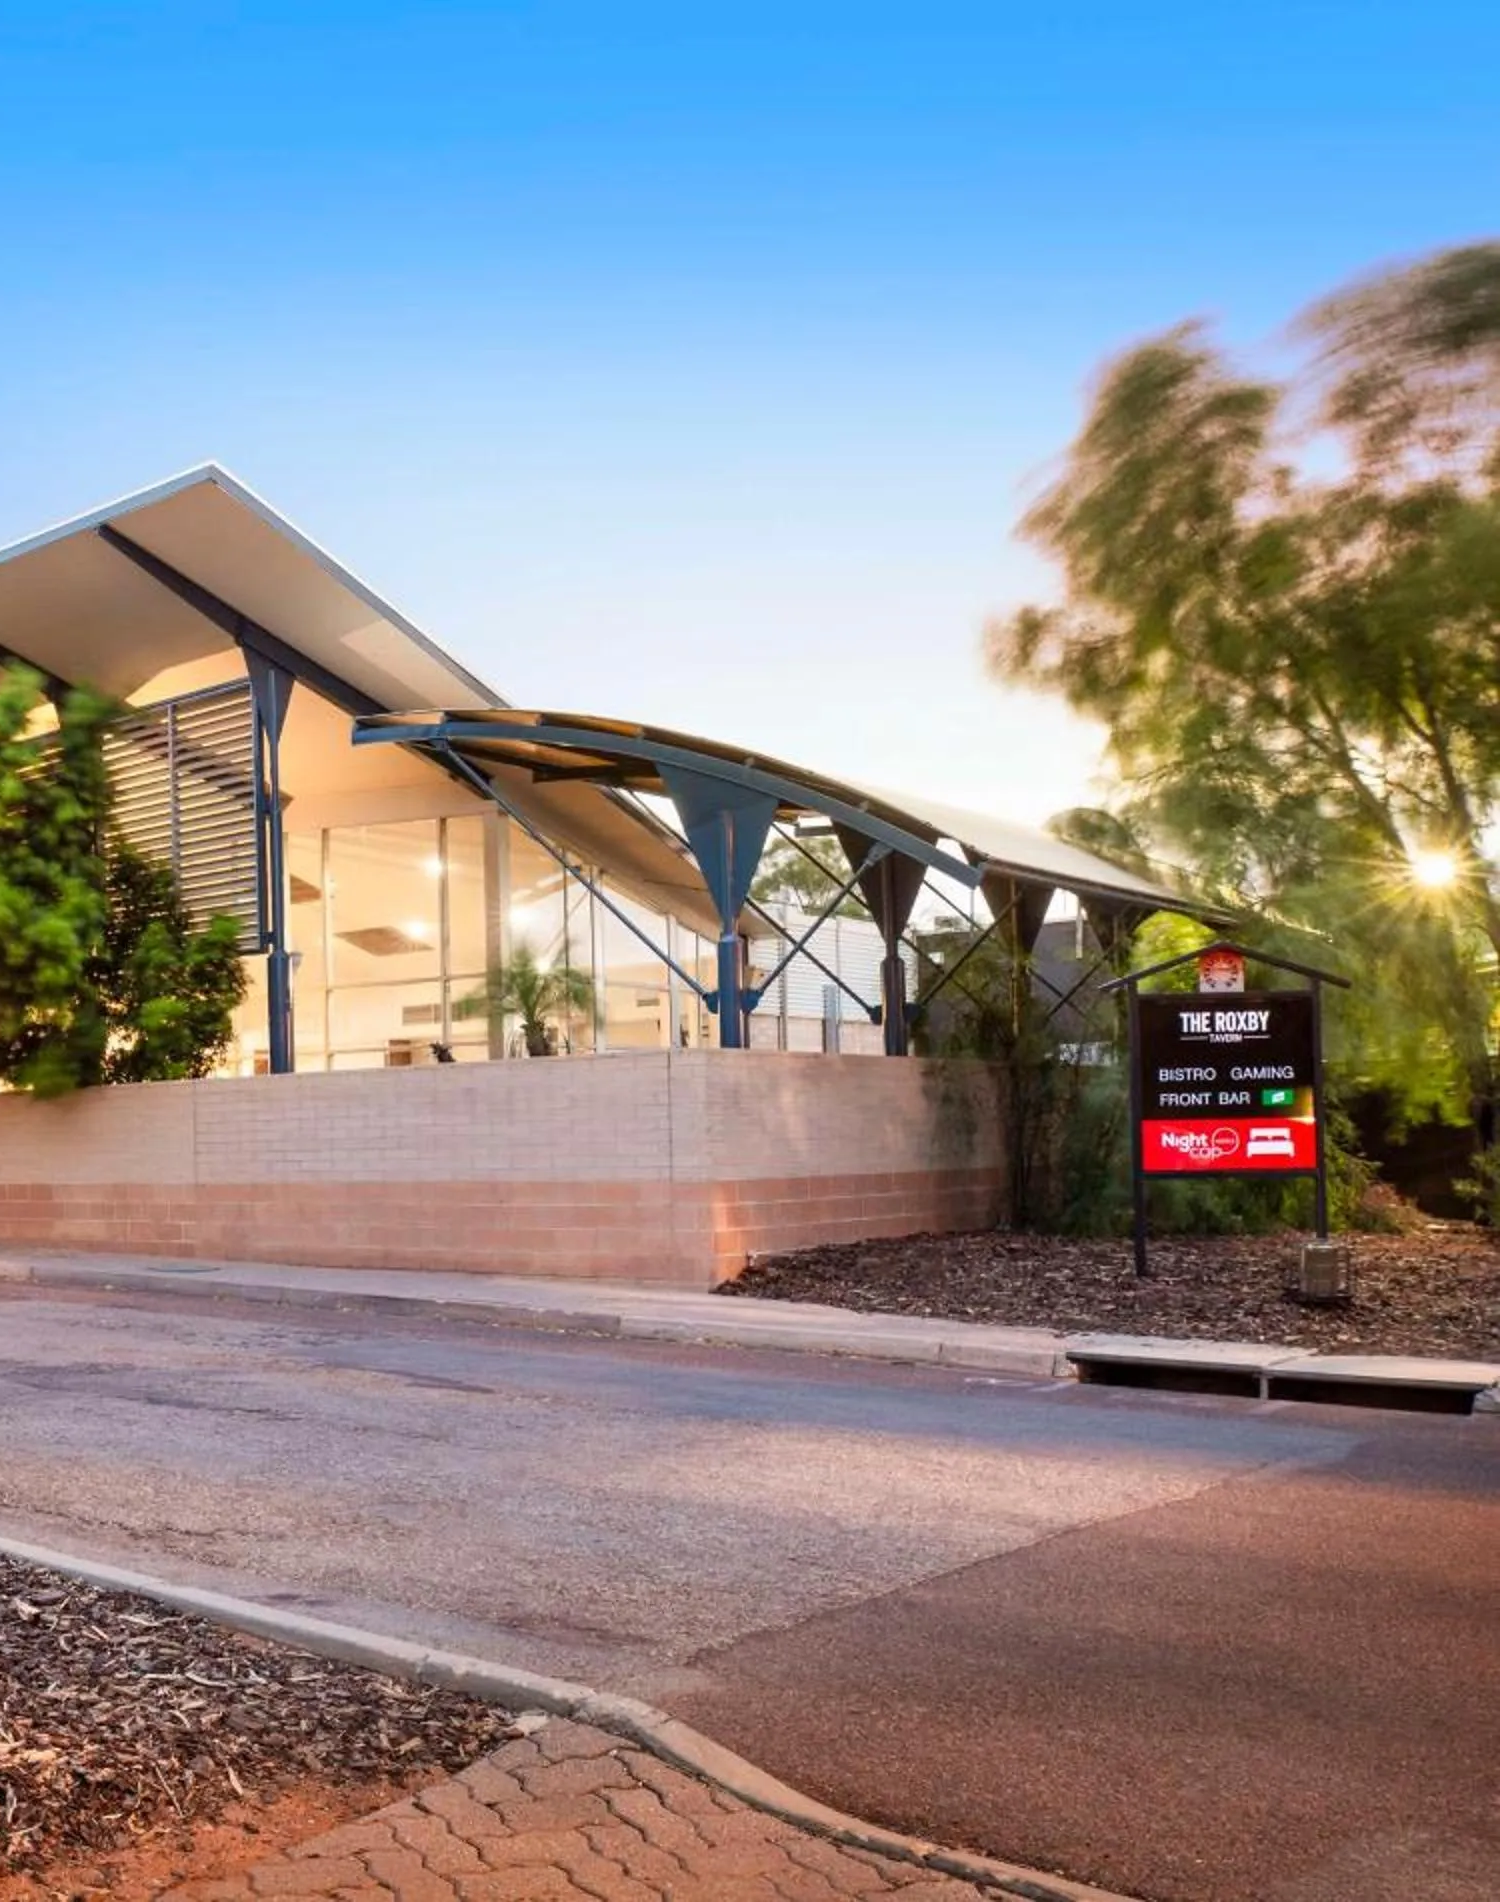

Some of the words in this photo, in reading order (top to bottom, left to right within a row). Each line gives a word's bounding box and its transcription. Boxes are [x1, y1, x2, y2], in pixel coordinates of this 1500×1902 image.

[1179, 1011, 1211, 1033] THE
[1215, 1010, 1270, 1032] ROXBY
[1159, 1067, 1217, 1082] BISTRO
[1230, 1065, 1295, 1080] GAMING
[1159, 1092, 1212, 1107] FRONT
[1218, 1091, 1251, 1105] BAR
[1161, 1131, 1208, 1153] Night
